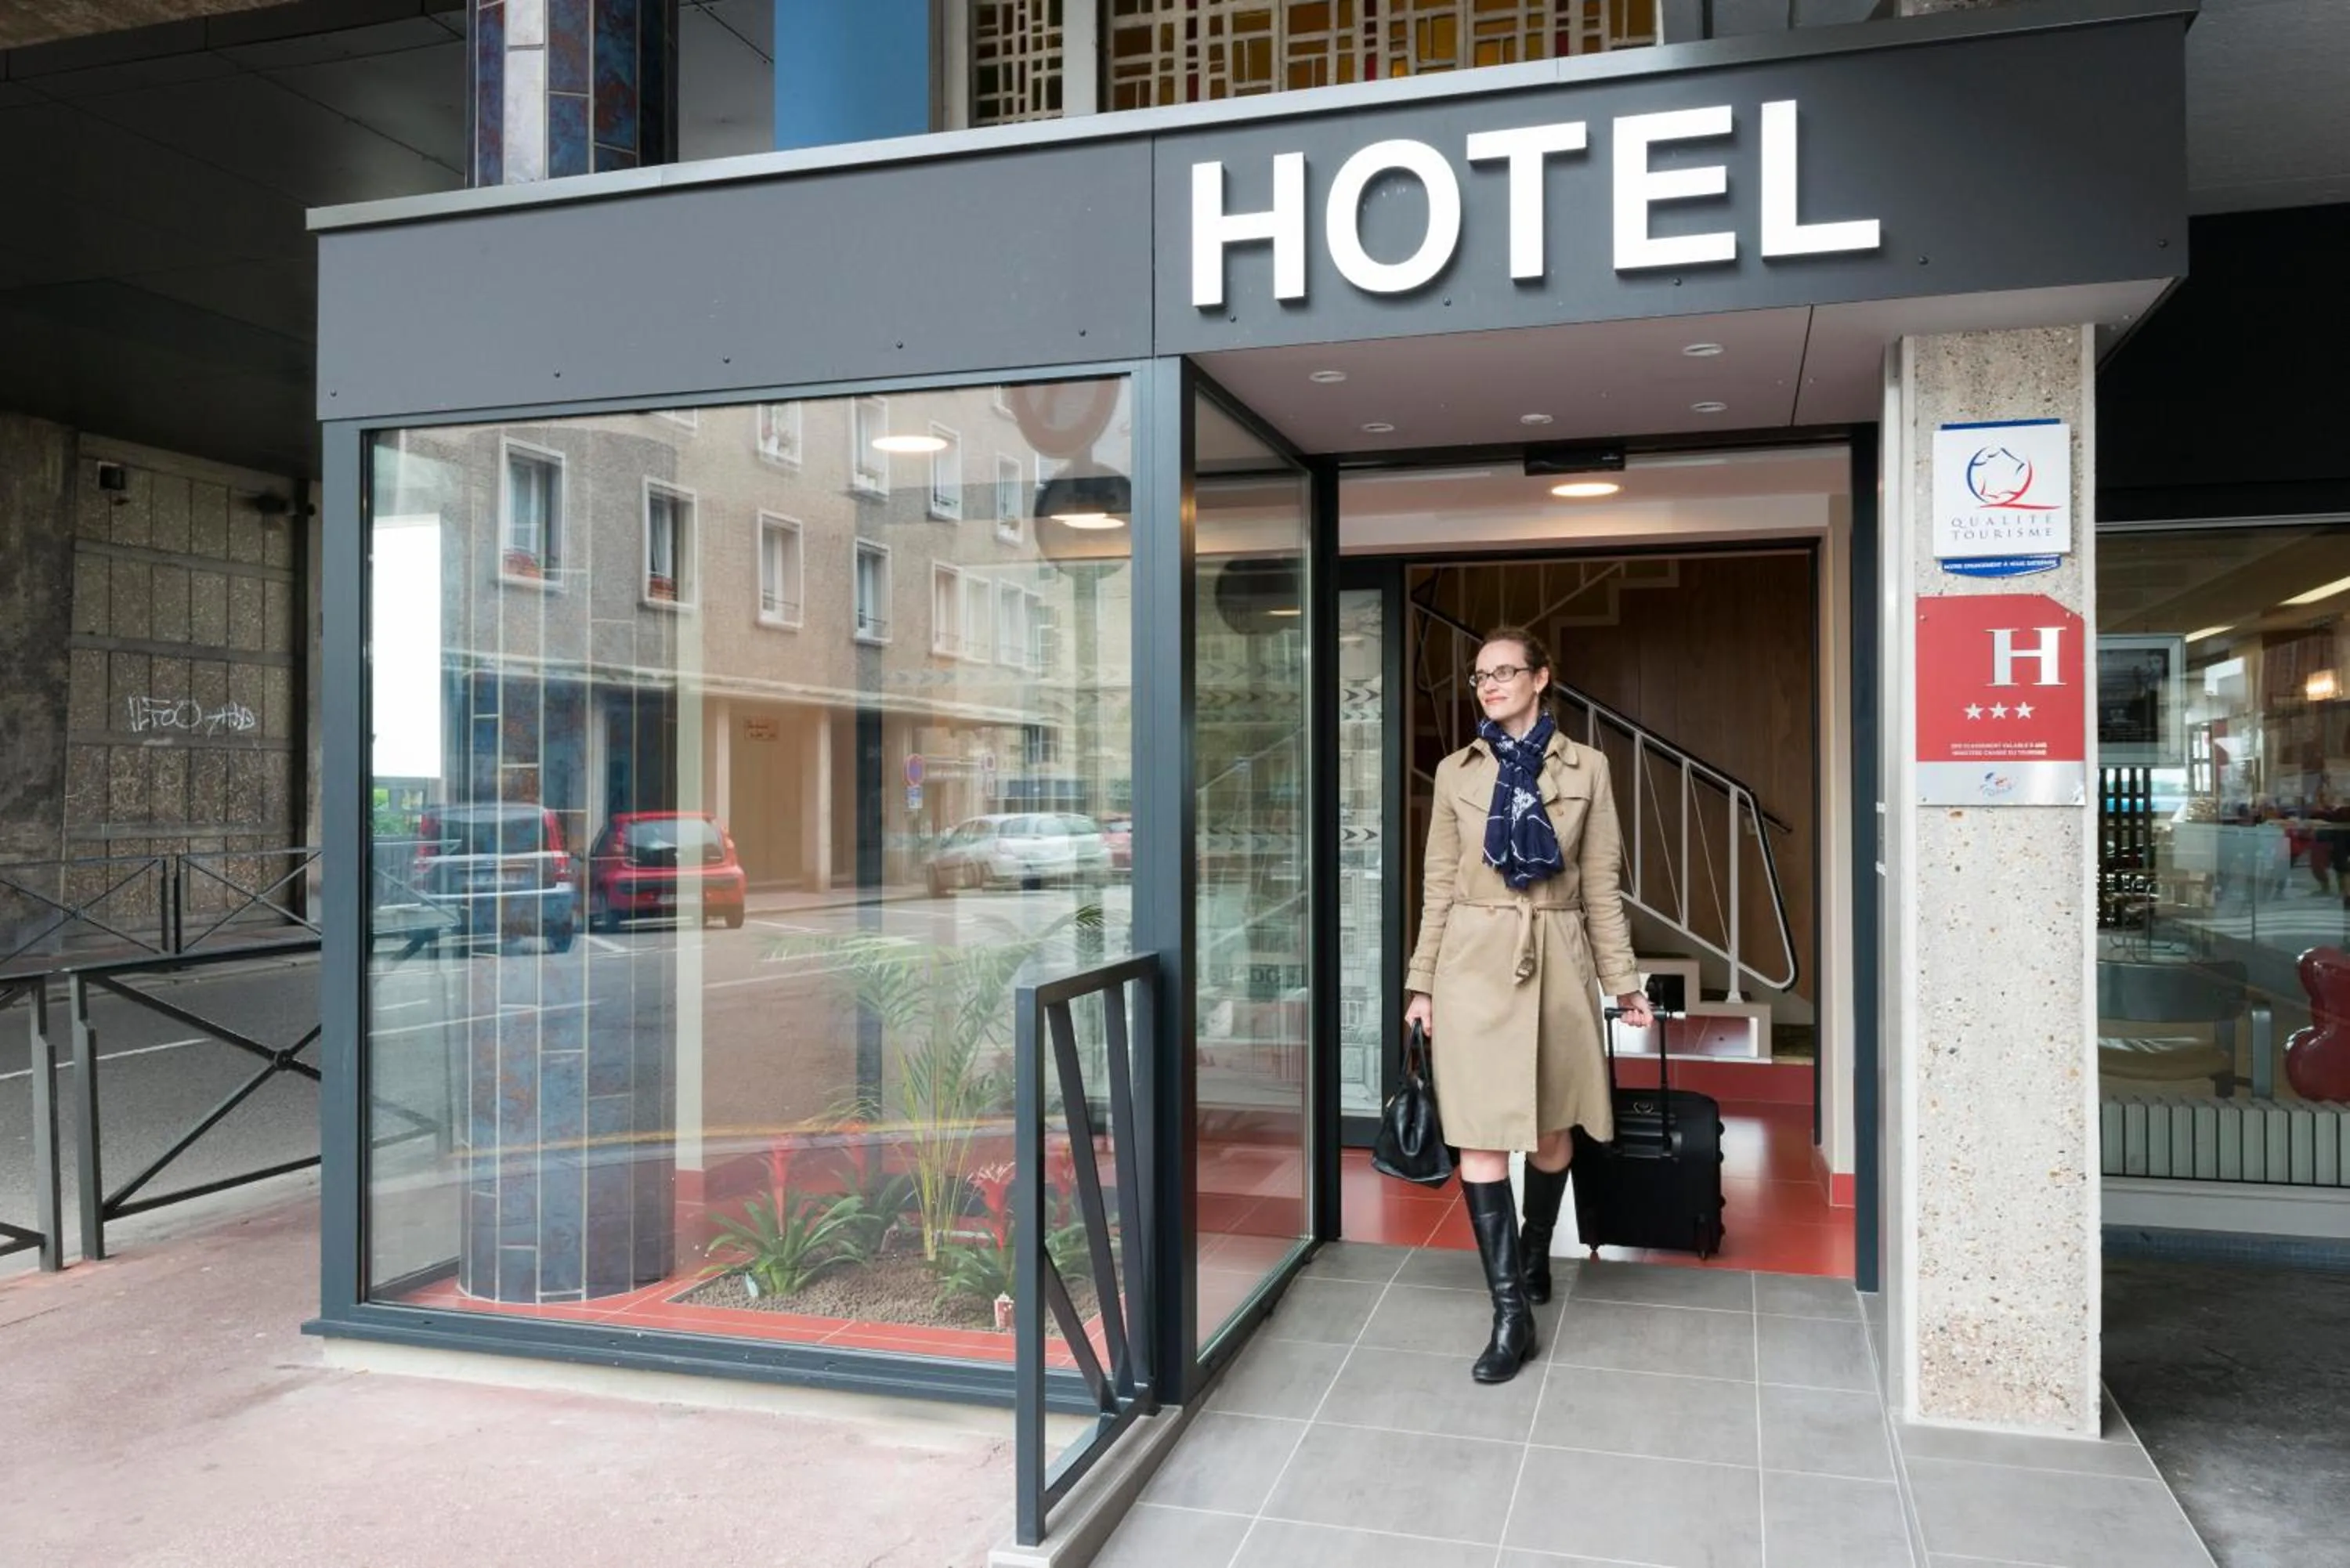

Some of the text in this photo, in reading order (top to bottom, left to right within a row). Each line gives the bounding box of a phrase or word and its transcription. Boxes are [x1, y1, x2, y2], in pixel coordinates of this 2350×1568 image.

[1191, 99, 1880, 306] HOTEL
[1950, 528, 2052, 541] TOURISME
[1985, 627, 2067, 686] H
